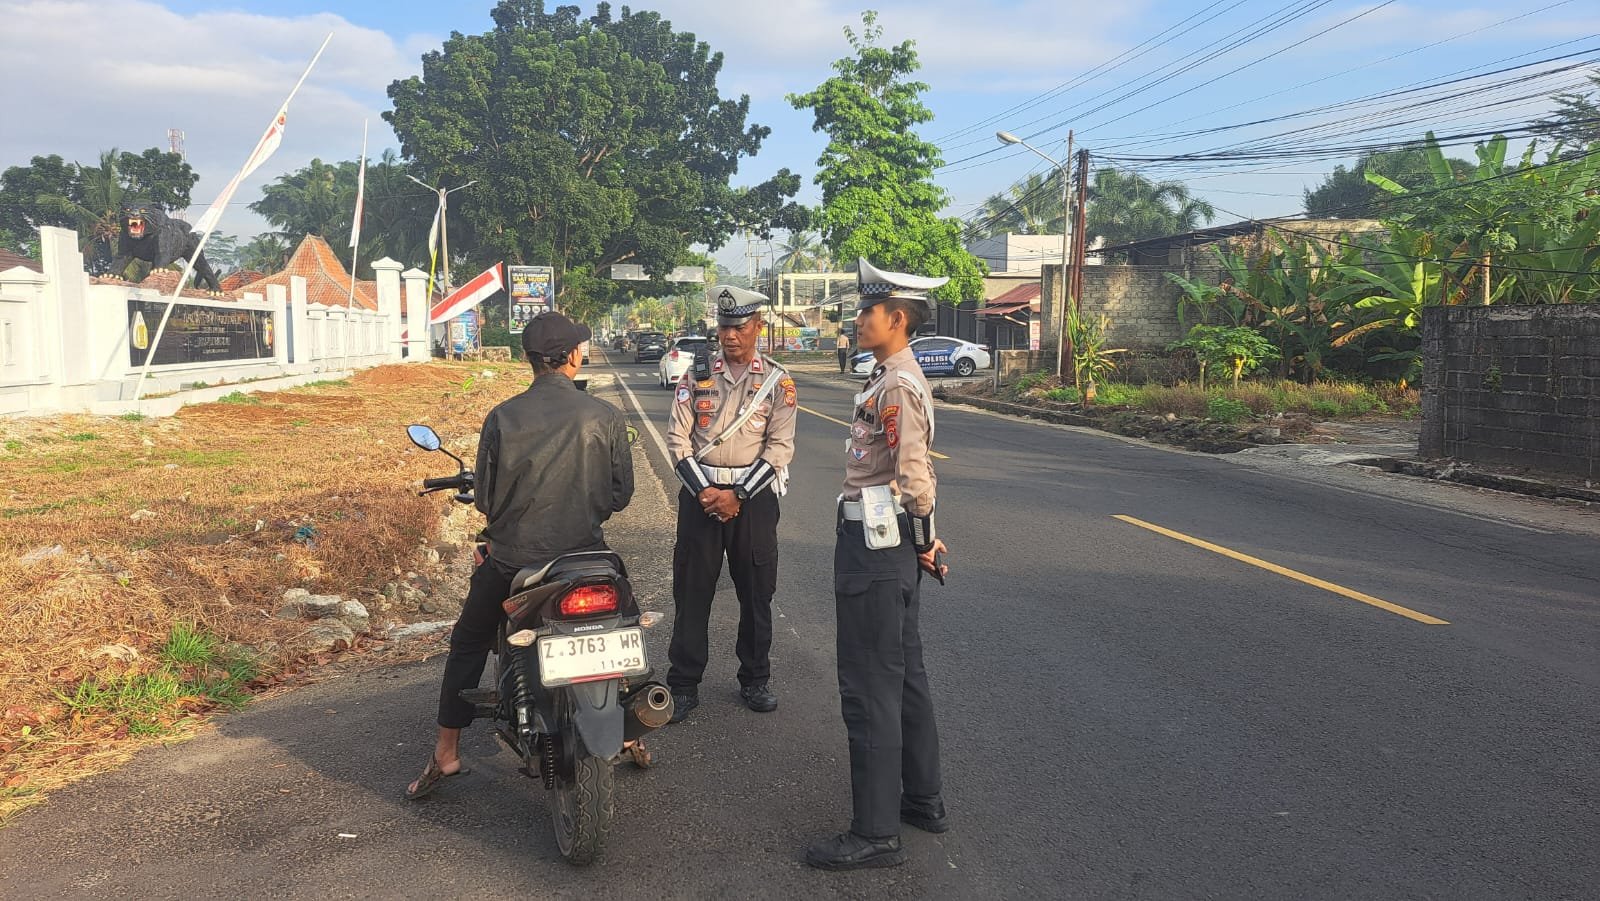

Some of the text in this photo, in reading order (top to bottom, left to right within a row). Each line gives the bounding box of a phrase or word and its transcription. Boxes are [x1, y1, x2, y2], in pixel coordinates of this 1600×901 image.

[918, 355, 948, 363] POLISI
[573, 624, 604, 632] HONDA
[543, 632, 640, 659] Z 3763 WR
